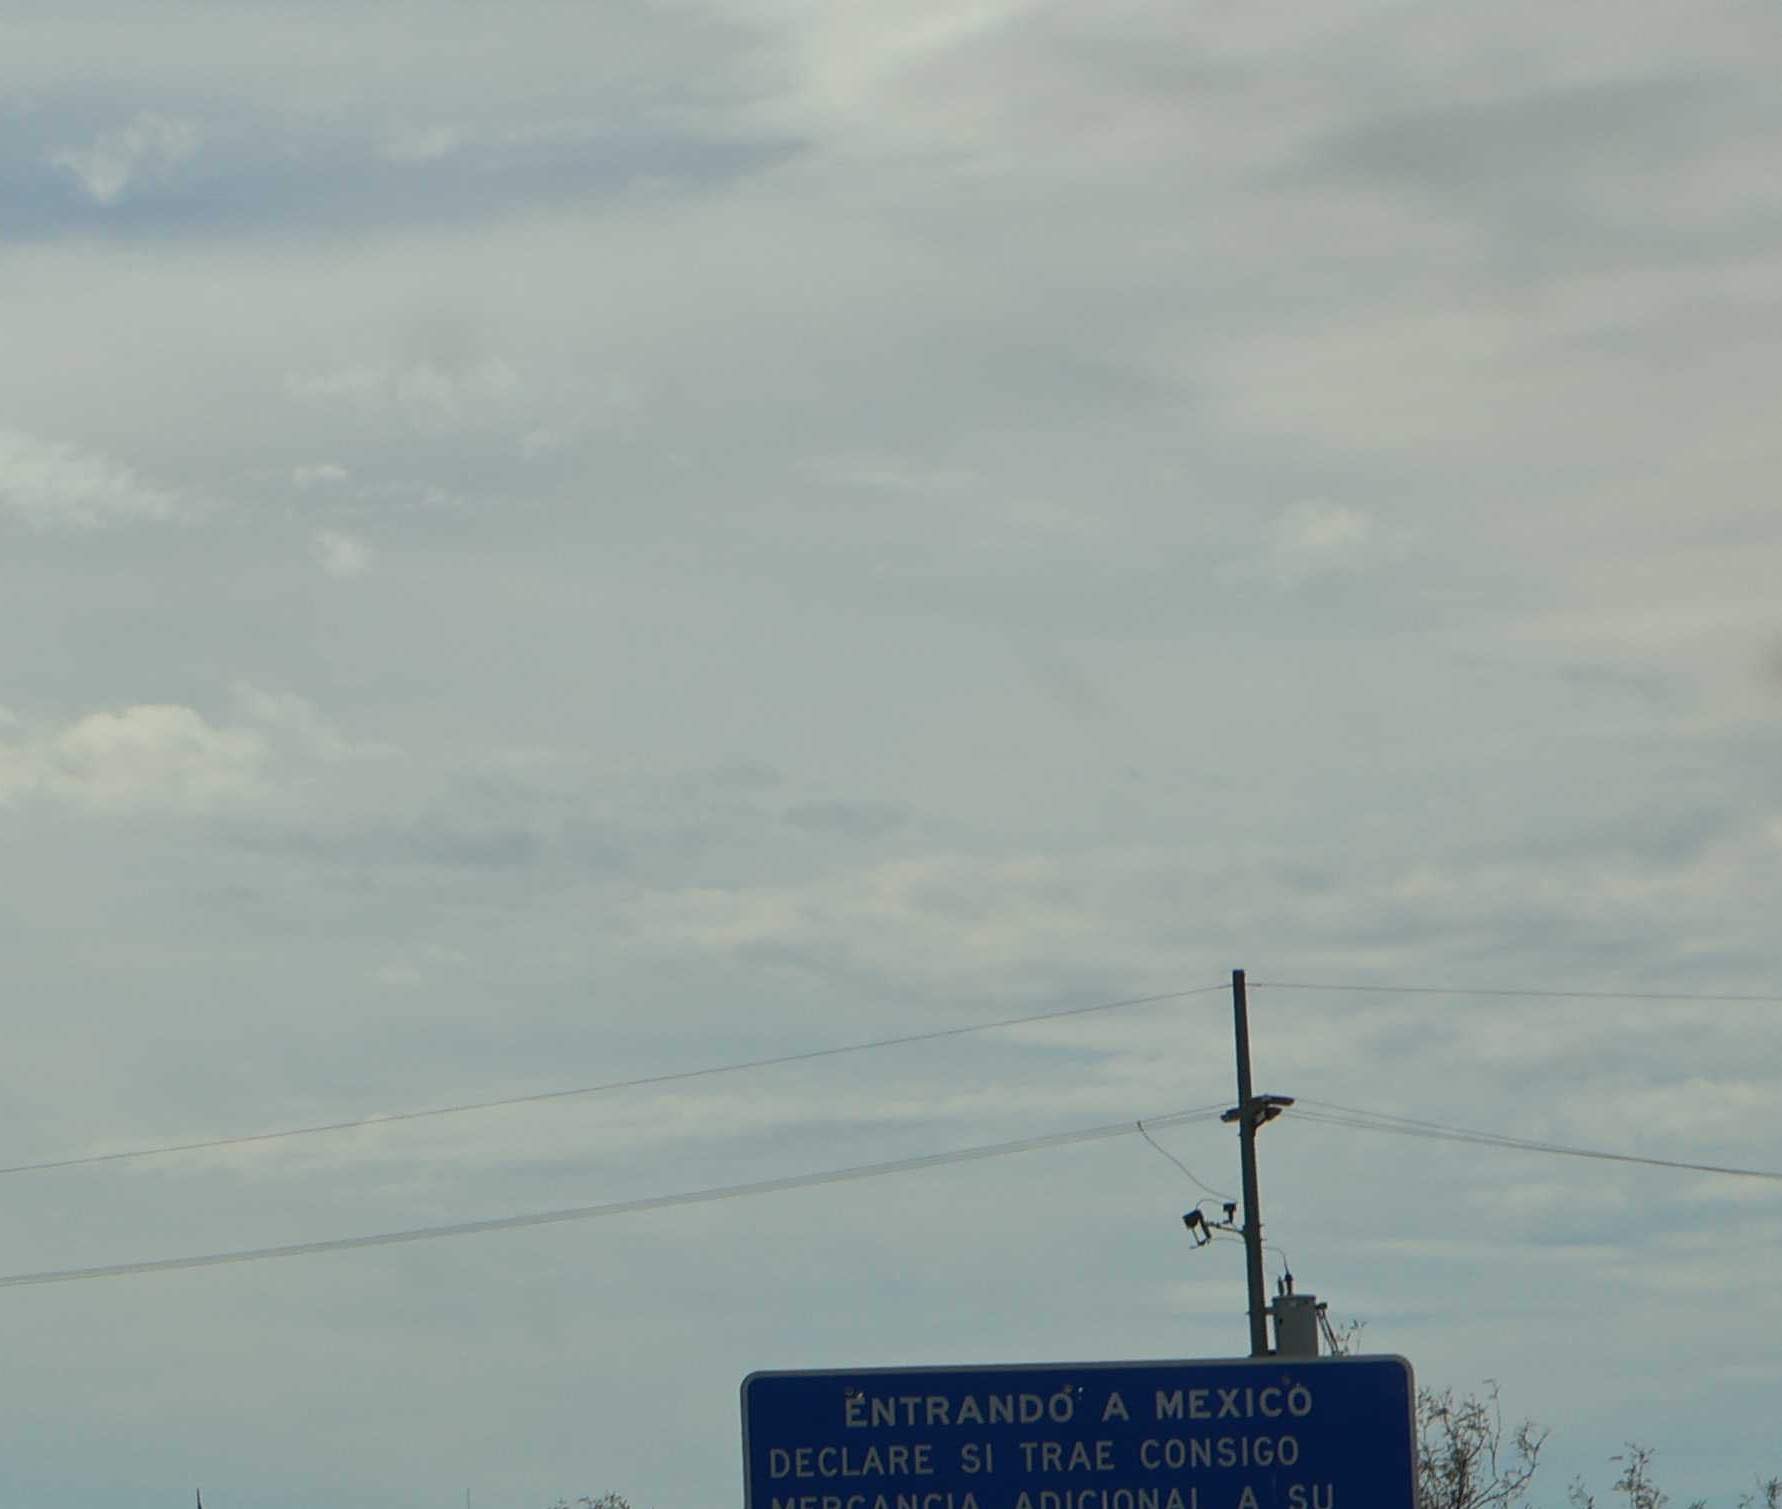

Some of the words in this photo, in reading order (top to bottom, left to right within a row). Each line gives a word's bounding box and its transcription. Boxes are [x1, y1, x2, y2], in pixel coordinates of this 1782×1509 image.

[845, 1392, 1073, 1426] ENTRANDO
[1102, 1392, 1128, 1421] A
[1156, 1386, 1311, 1419] MEXICO
[770, 1445, 933, 1478] DECLARE
[962, 1444, 992, 1473] SI
[1020, 1441, 1114, 1472] TRAE
[1141, 1436, 1298, 1468] CONSIGO
